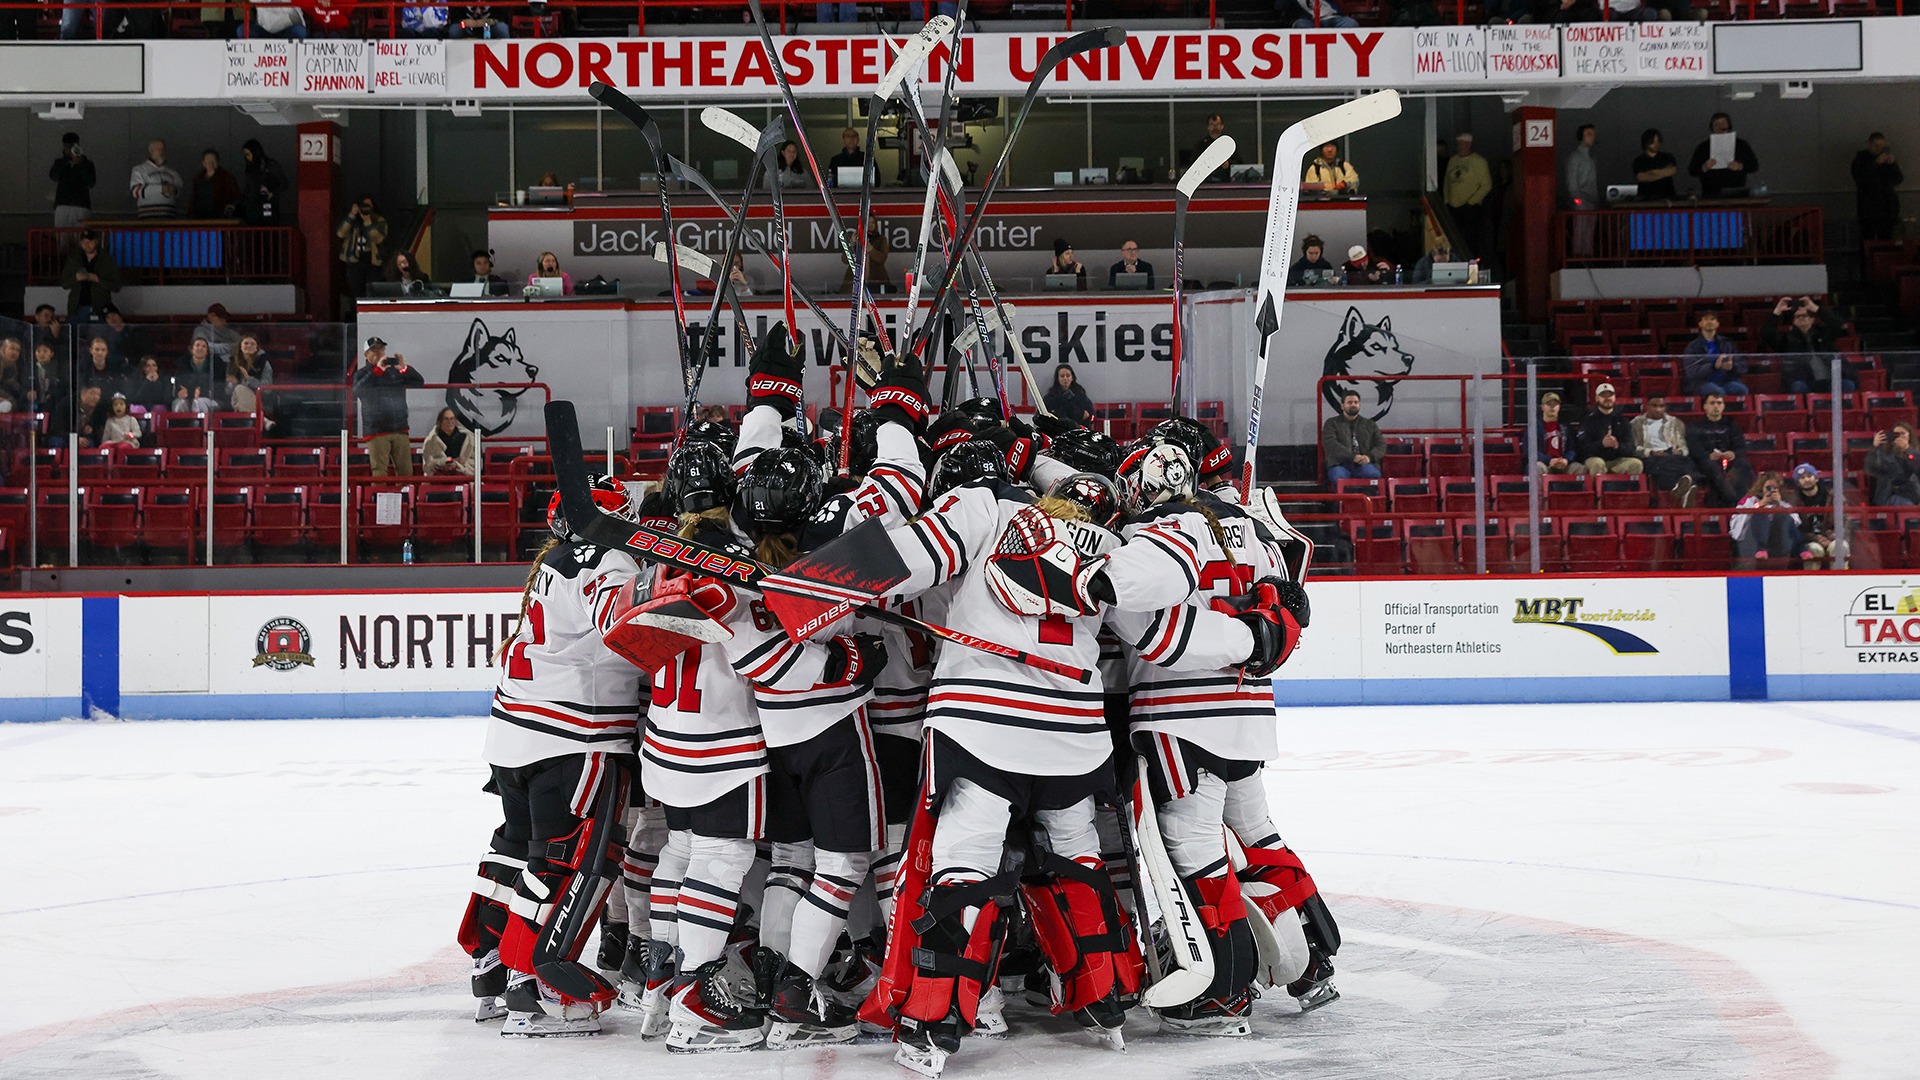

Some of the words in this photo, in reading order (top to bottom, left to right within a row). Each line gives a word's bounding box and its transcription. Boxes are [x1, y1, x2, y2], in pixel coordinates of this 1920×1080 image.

[1416, 32, 1438, 48] ONE
[1446, 31, 1460, 48] IN
[1465, 32, 1475, 47] A
[1491, 28, 1519, 41] FINAL
[1524, 28, 1553, 40] PAIGE
[263, 43, 287, 54] MISS
[303, 42, 338, 56] THANK
[342, 43, 364, 57] YOU
[416, 43, 437, 56] YOU
[1501, 42, 1513, 52] IN
[1521, 42, 1543, 52] THE
[1572, 45, 1587, 58] IN
[1599, 46, 1625, 58] OUR
[1692, 40, 1709, 51] YOU
[229, 56, 246, 67] YOU
[253, 56, 287, 68] JADEN
[394, 58, 421, 67] WERE
[1008, 31, 1384, 82] UNIVERSITY
[305, 57, 359, 73] CAPTAIN
[1576, 59, 1628, 74] HEARTS
[227, 71, 290, 87] DAWG-DEN
[303, 74, 365, 92] SHANNON
[1529, 125, 1549, 142] 24
[303, 139, 324, 156] 22
[579, 222, 660, 253] Jack
[675, 220, 793, 253] Grinold
[810, 219, 912, 250] Mia
[928, 218, 1043, 250] Cnter
[971, 298, 991, 343] BAUER
[752, 379, 803, 399] BAUER
[870, 389, 922, 412] BAUER
[1247, 383, 1263, 446] BAUER
[690, 467, 701, 477] 61
[982, 462, 994, 472] 92
[754, 500, 765, 511] 21
[624, 530, 757, 583] BAUER
[1384, 602, 1422, 616] Official
[1423, 602, 1499, 617] Transportation
[1512, 597, 1584, 624] MBT
[1580, 609, 1656, 623] worldwide
[1865, 594, 1895, 611] EL
[796, 598, 850, 639] BAUER
[1385, 622, 1423, 635] Partner
[1425, 622, 1436, 634] of
[1385, 642, 1454, 654] Northeastern
[1455, 641, 1501, 654] Athletics
[1858, 652, 1919, 663] EXTRAS
[545, 870, 585, 954] TRUE
[1169, 877, 1203, 963] TRUE
